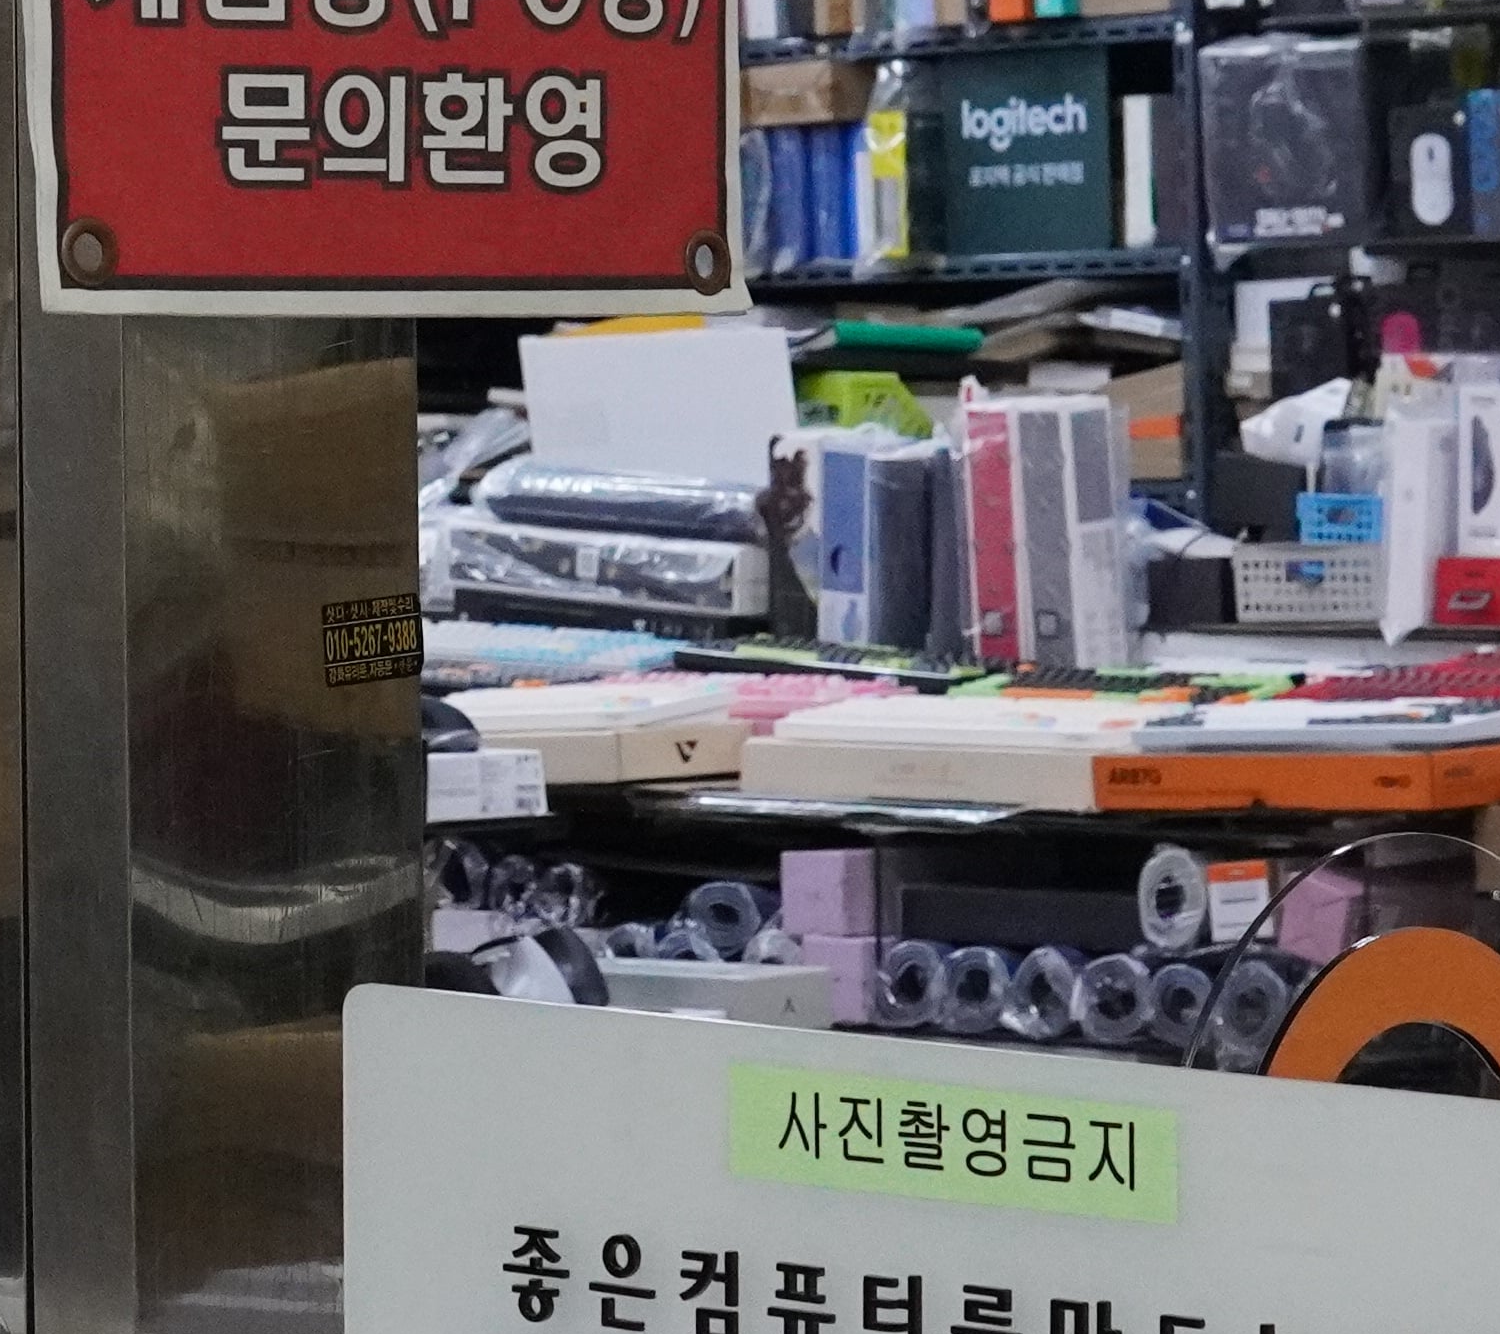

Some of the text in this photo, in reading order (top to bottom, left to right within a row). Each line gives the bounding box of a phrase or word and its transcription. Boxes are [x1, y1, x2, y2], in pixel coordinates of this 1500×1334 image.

[219, 68, 606, 190] 문의환영
[961, 91, 1088, 152] logitech
[776, 1087, 1141, 1196] 사진촬영금지
